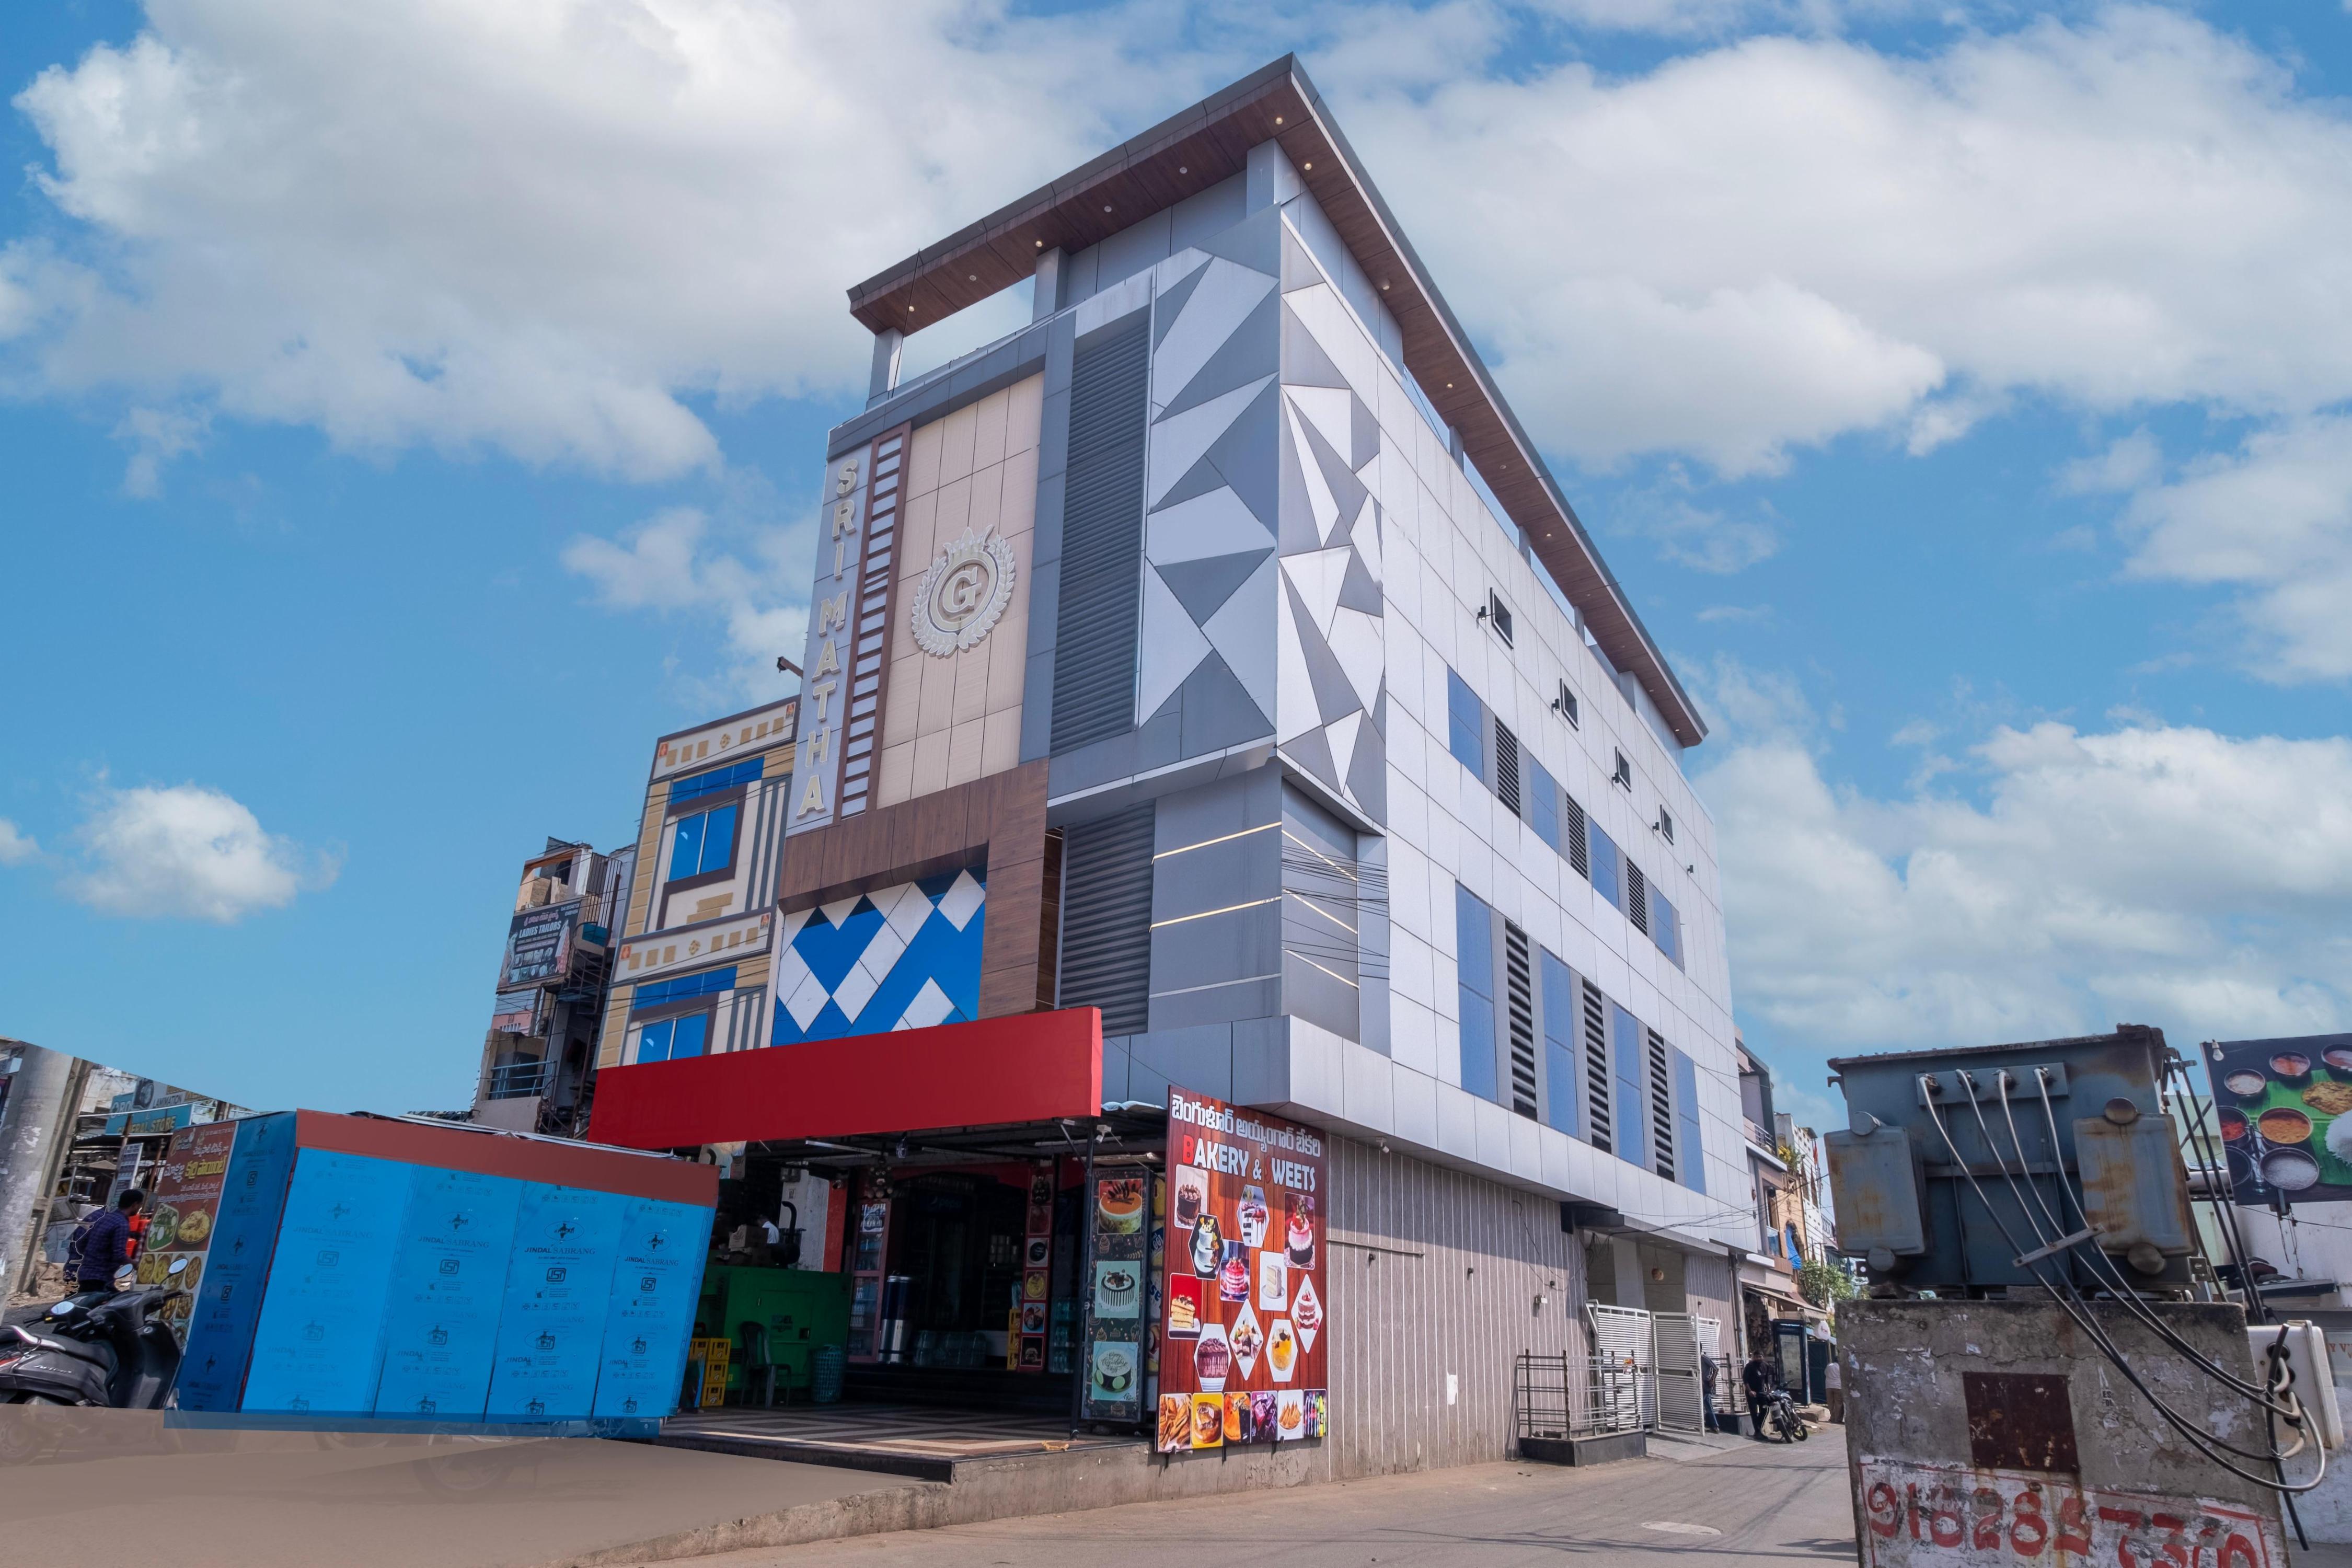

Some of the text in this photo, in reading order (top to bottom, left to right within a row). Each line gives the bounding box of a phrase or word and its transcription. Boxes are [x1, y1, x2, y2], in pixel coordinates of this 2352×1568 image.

[942, 566, 982, 618] G
[797, 458, 858, 820] SRI MATHA
[519, 920, 561, 938] LADIES TAILORS
[151, 1116, 176, 1132] STORE
[1183, 1134, 1316, 1192] BAKERY & SWEETS
[418, 1236, 490, 1248] JINDAL SABRANG
[647, 1258, 679, 1266] SABRANG
